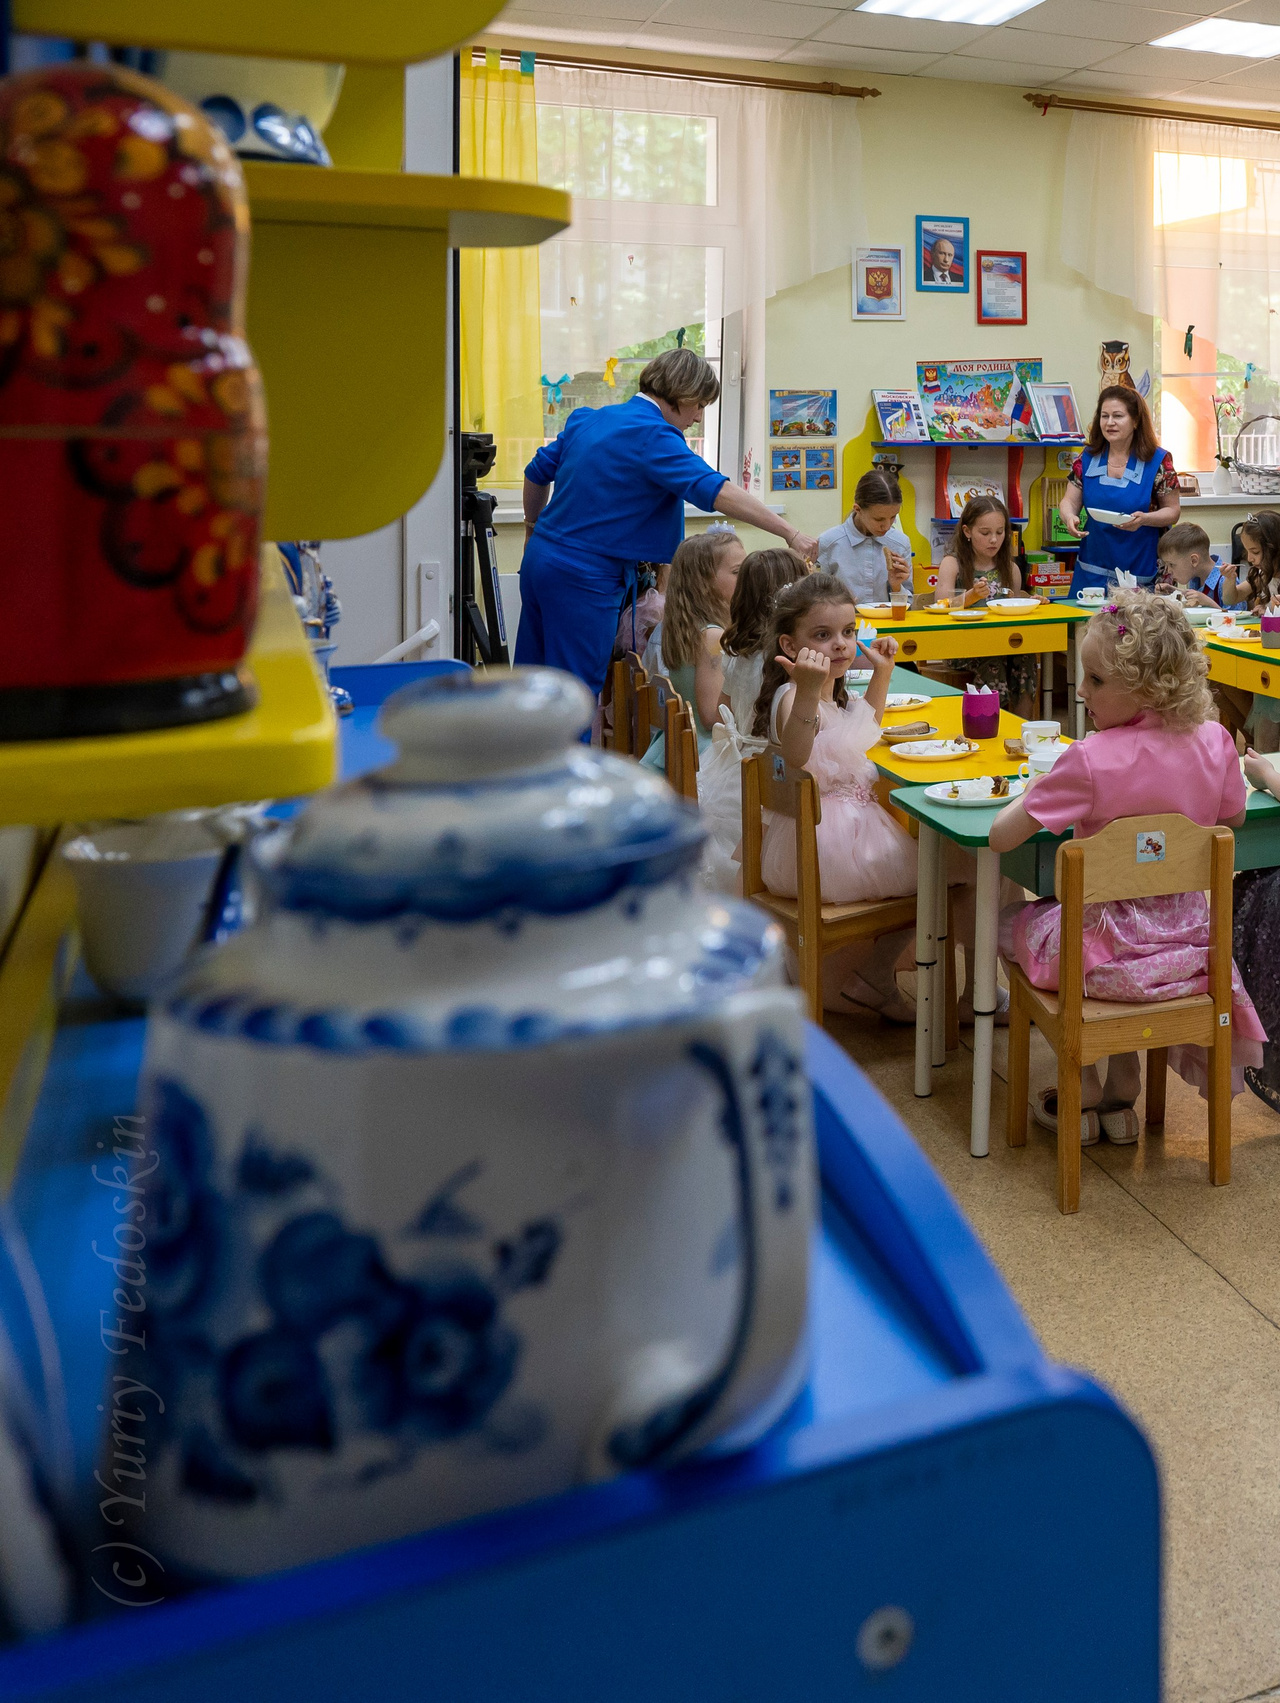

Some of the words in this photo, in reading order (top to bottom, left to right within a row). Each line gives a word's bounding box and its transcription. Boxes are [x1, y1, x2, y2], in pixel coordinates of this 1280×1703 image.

[953, 364, 974, 372] МОЯ
[976, 363, 1012, 372] РОДИНА
[1221, 1015, 1228, 1024] 2
